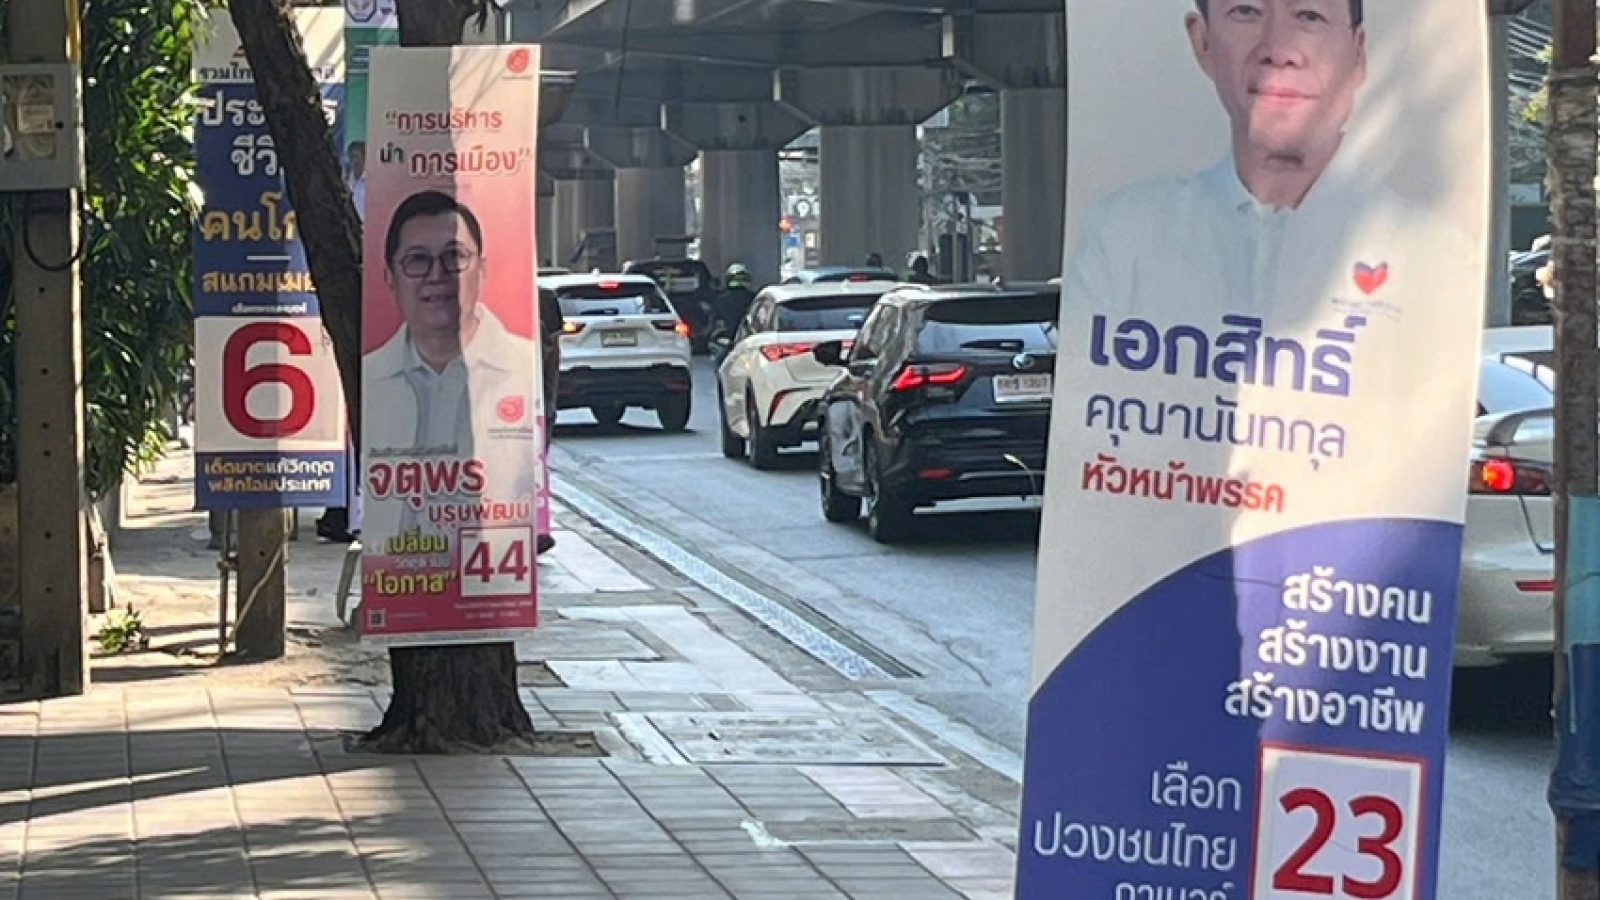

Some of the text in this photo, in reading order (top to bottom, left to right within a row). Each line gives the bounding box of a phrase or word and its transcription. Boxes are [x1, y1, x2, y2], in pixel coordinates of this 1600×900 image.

[380, 142, 532, 173] นำ การเมือง”
[222, 321, 315, 439] 6
[1090, 315, 1367, 397] เอกสิทธิ์
[1085, 394, 1346, 471] คุณานันทกุล
[368, 459, 485, 508] จตุพร
[1081, 453, 1286, 513] หัวหน้าพรรค
[464, 540, 528, 583] 44
[1283, 566, 1432, 624] สร้างคน
[1258, 620, 1428, 679] สร้างงาน
[1224, 671, 1424, 733] สร้างอาชีพ
[1151, 760, 1242, 811] เลือก
[1033, 811, 1237, 871] ปวงชนไทย
[1272, 787, 1404, 900] 23
